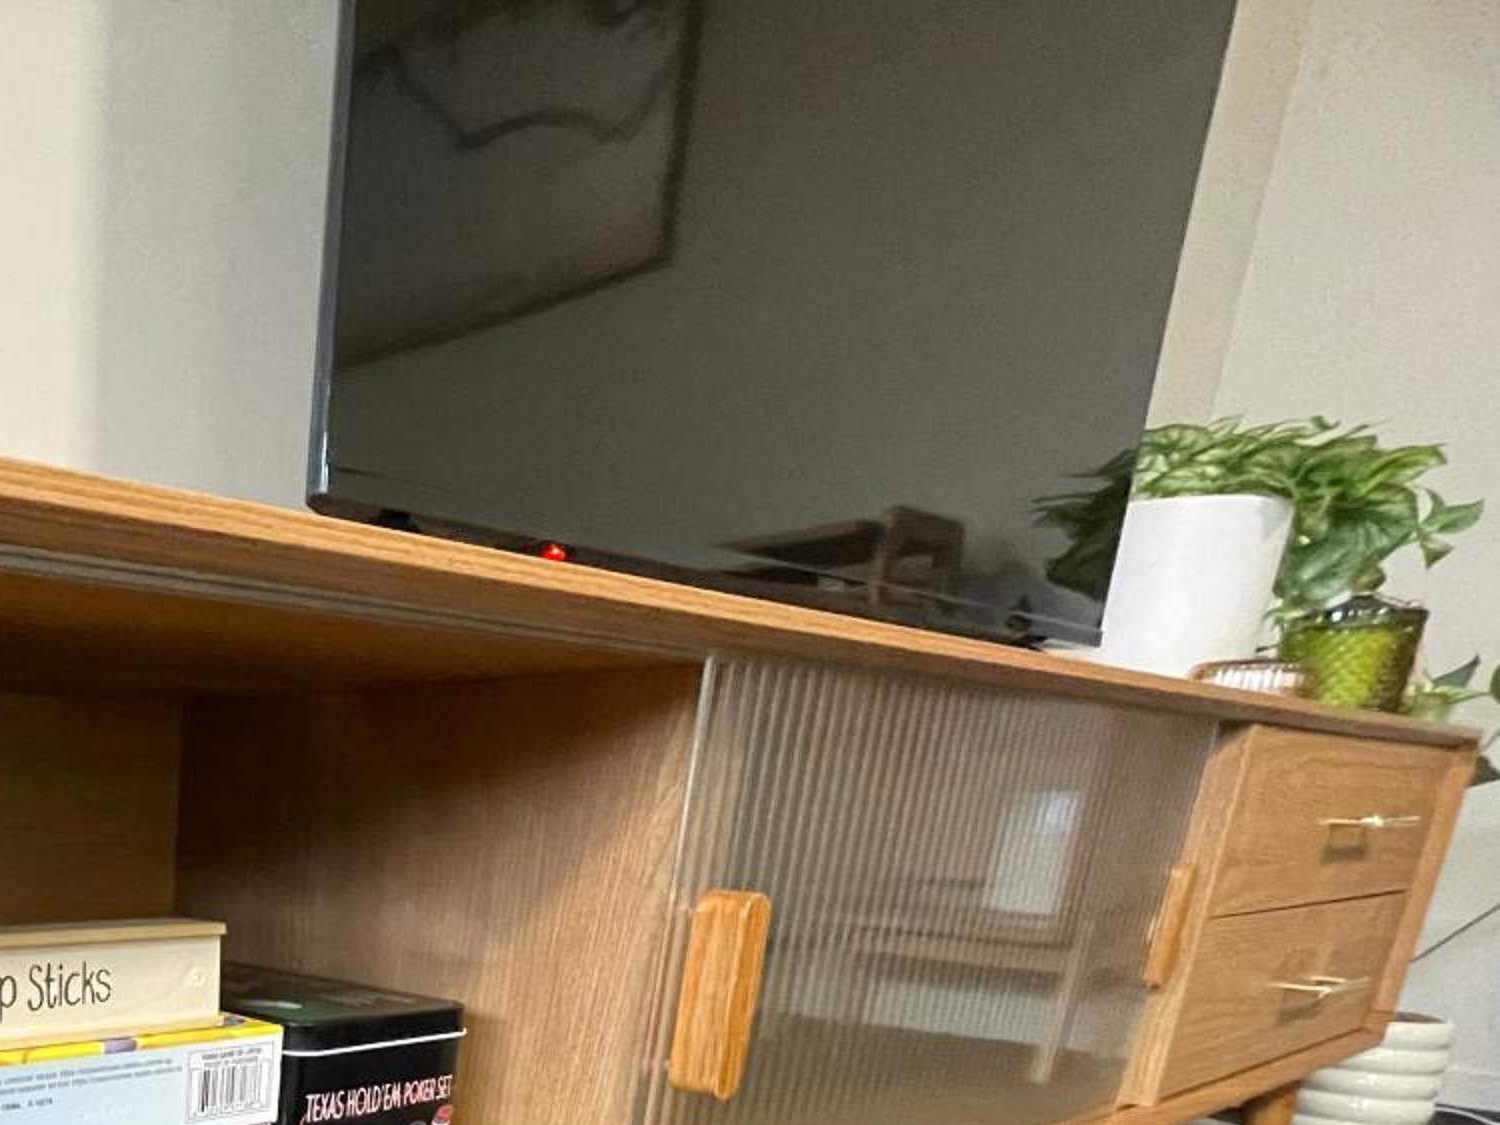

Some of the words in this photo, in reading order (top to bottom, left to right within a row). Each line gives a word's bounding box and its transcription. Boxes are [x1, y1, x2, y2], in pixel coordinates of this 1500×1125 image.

[28, 961, 112, 1011] Sticks
[305, 1090, 345, 1122] TEXAS
[346, 1082, 401, 1117] HOLD'EM
[403, 1078, 436, 1106] POKER
